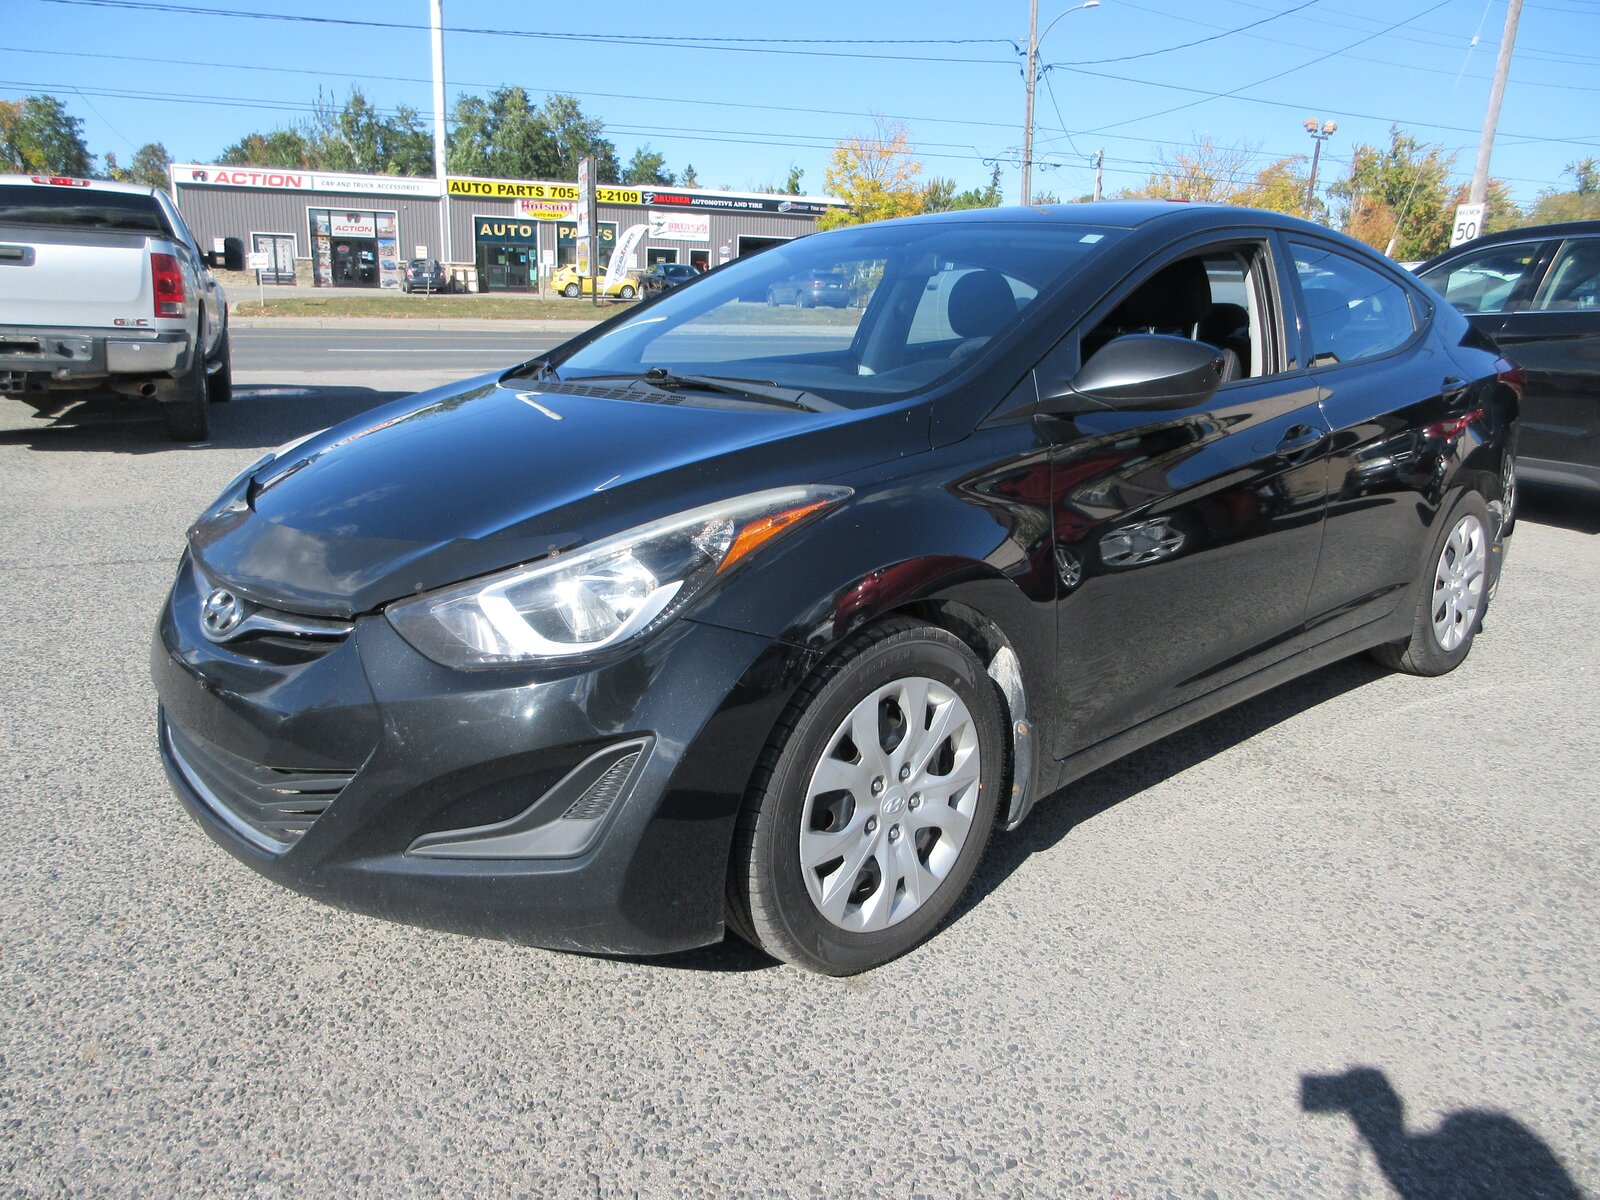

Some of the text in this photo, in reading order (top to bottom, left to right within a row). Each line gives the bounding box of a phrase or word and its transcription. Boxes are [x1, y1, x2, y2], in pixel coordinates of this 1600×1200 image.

[214, 171, 302, 188] ACTION
[377, 183, 421, 191] ACCESSORIES
[451, 182, 638, 203] AUTO PARTS 705-3-2109
[653, 194, 691, 205] BRUISER
[691, 198, 733, 207] AUTOMOTIVE
[335, 225, 373, 233] ACTION
[480, 223, 613, 241] AUTO PAS
[1455, 222, 1476, 241] 50
[113, 318, 149, 327] GMC
